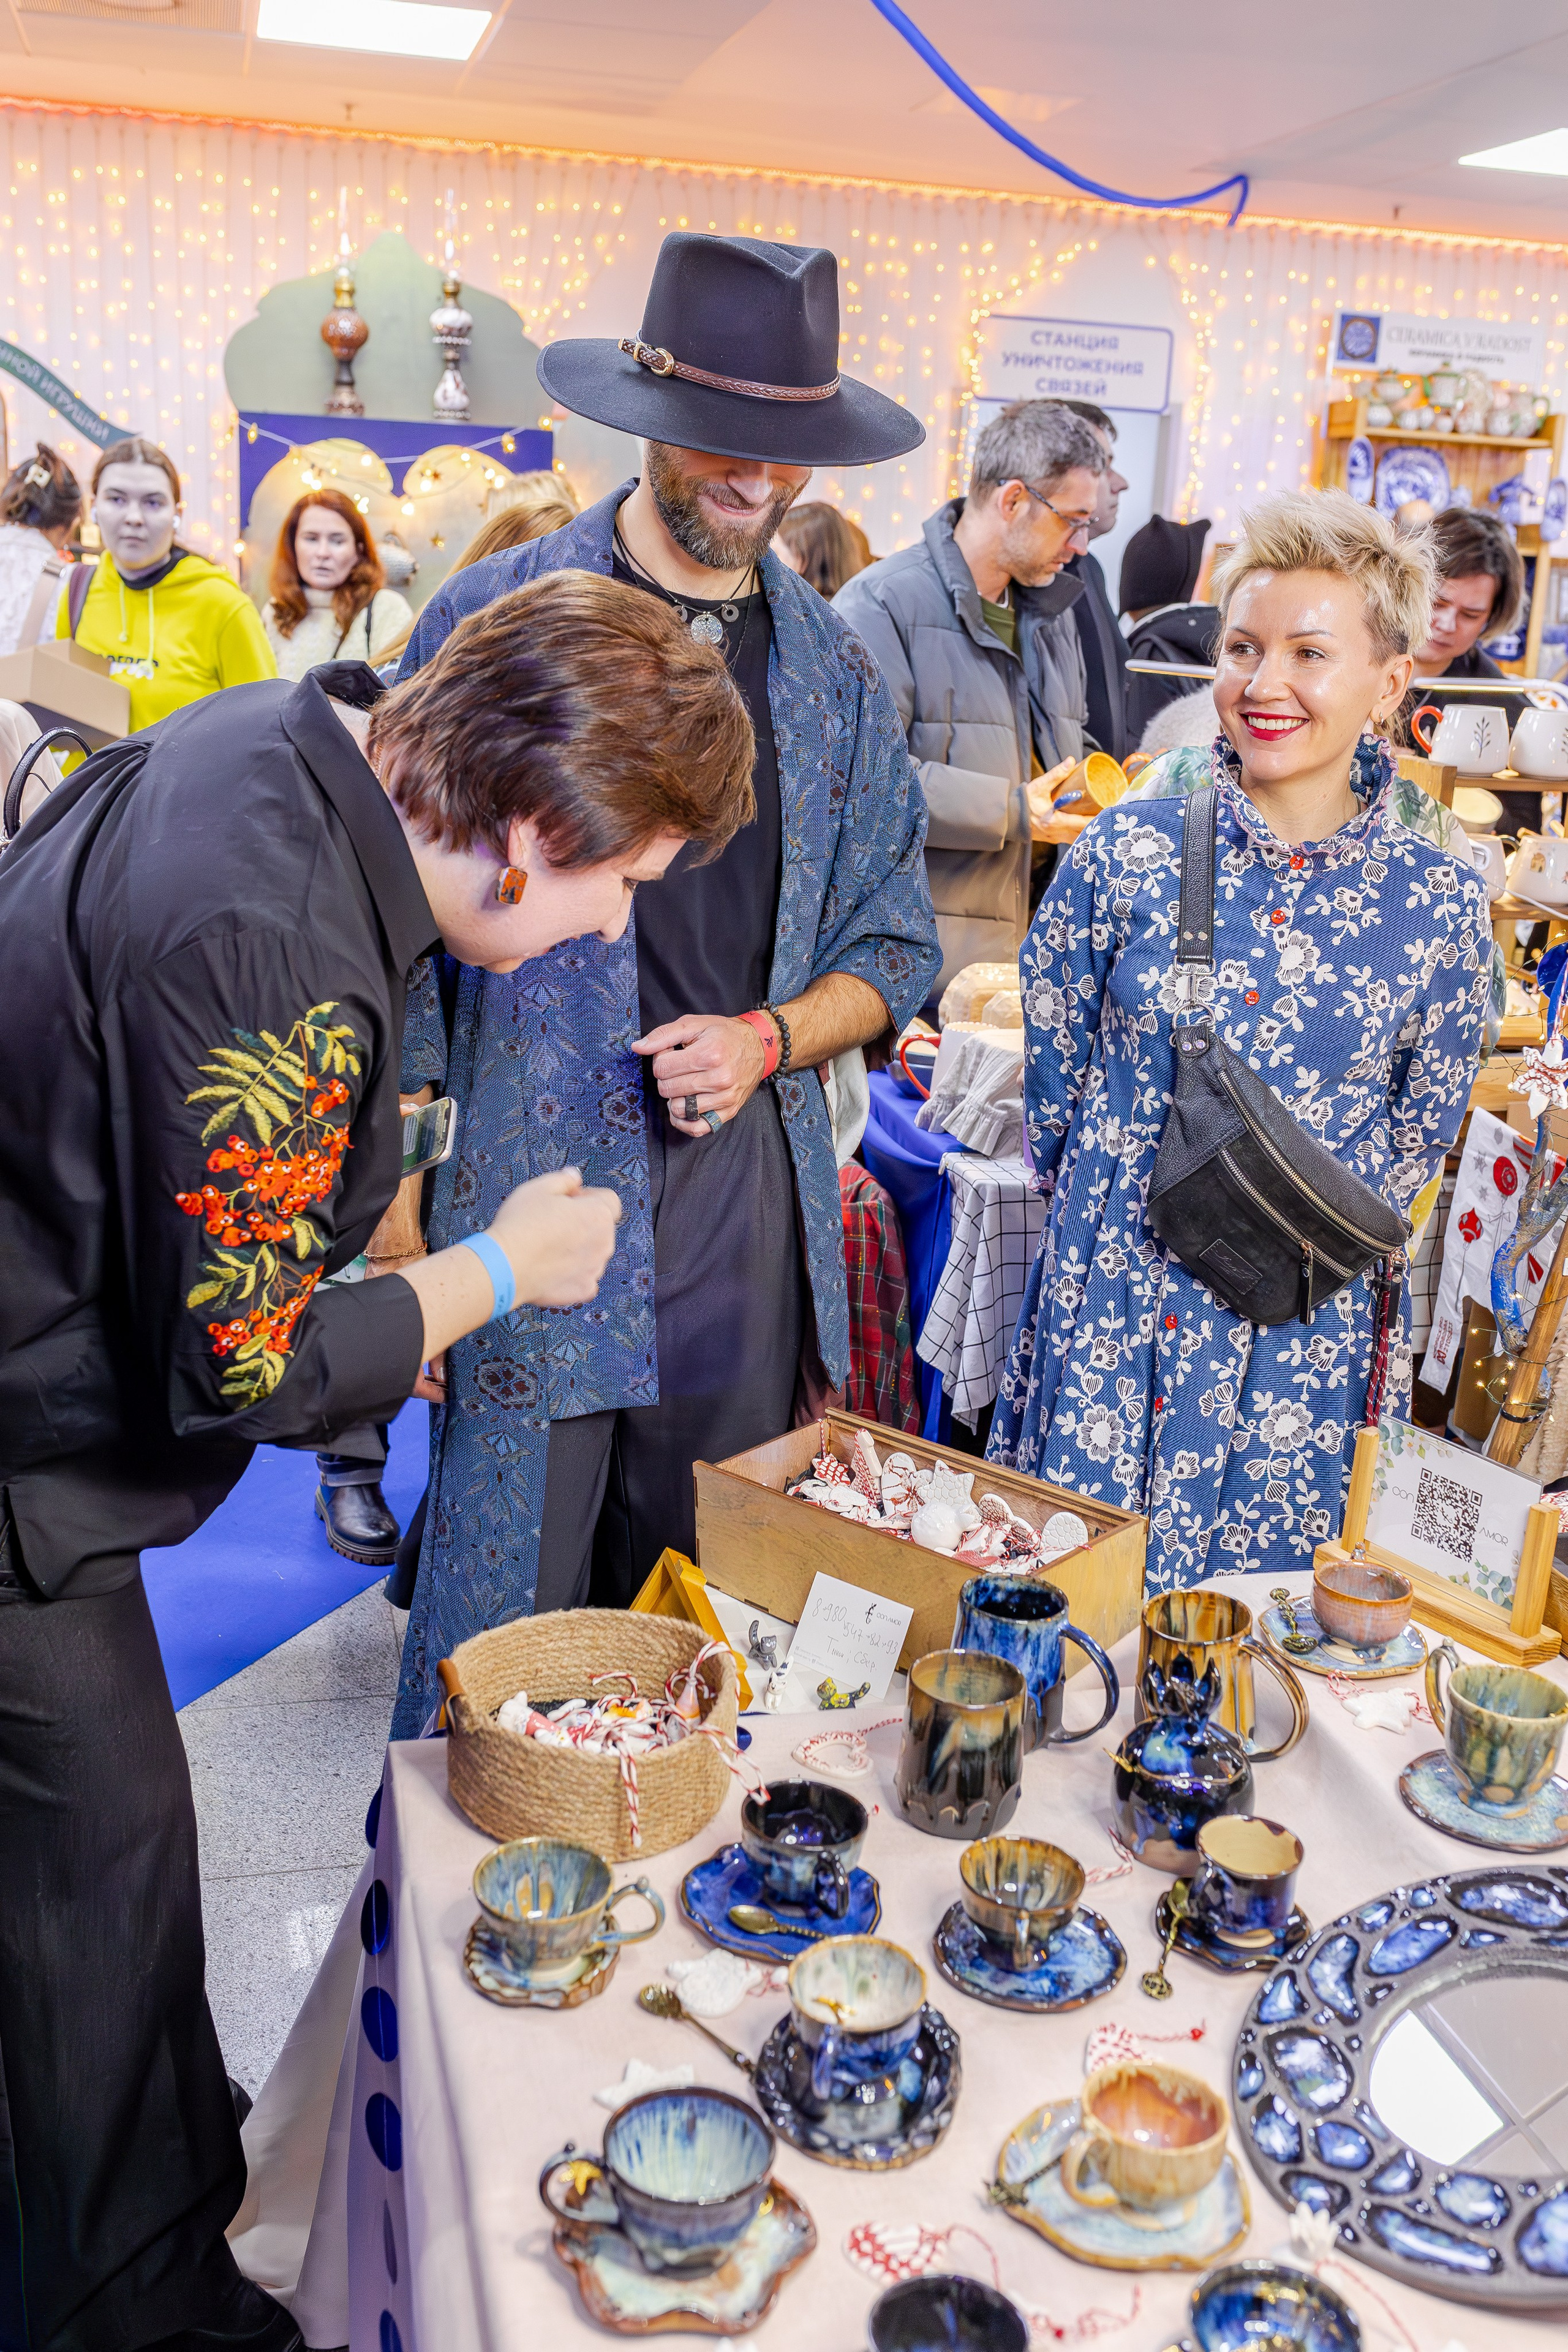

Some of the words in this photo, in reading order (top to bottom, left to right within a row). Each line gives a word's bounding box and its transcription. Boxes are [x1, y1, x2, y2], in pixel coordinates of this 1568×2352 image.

[1030, 330, 1120, 351] СТАНЦИЯ
[1002, 351, 1144, 375] УНИЧТОЖЕНИЯ
[1035, 377, 1107, 396] СВЯЗЕЙ
